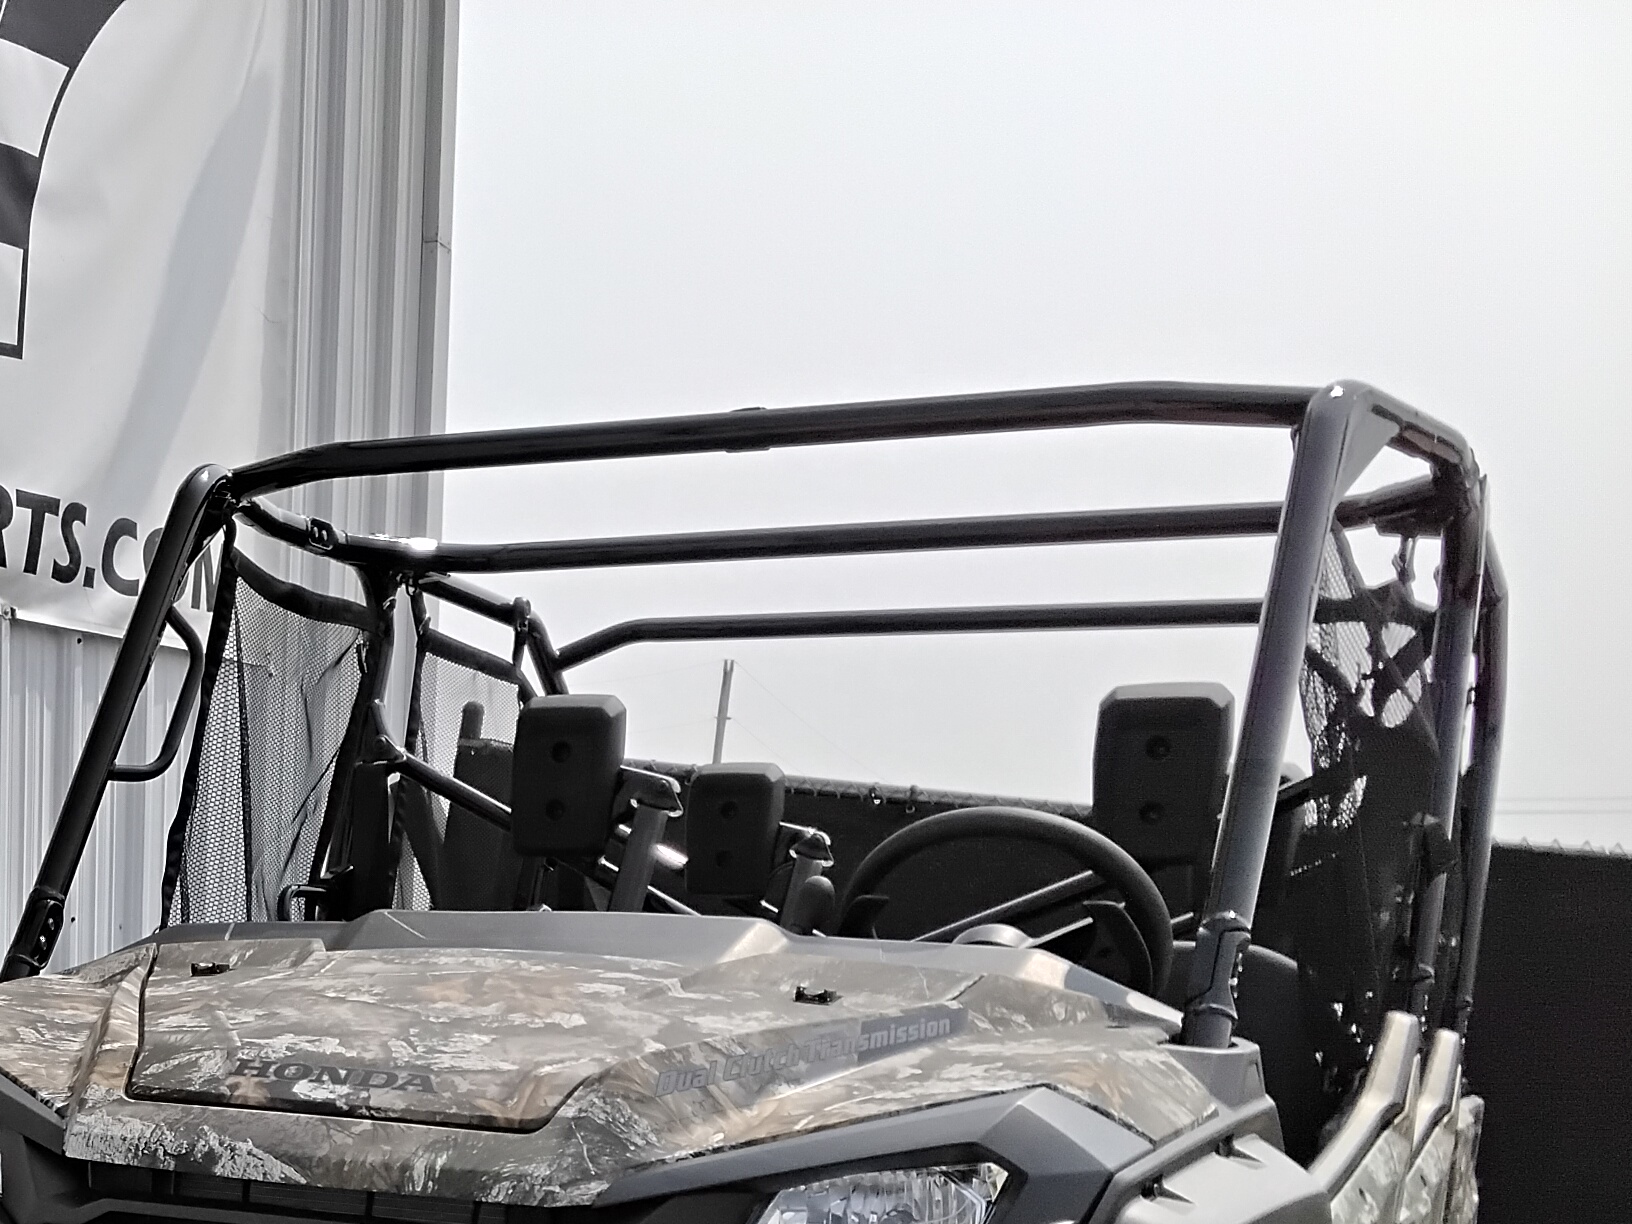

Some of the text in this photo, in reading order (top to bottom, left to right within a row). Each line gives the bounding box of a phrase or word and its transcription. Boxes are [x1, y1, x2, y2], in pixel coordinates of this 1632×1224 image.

[227, 1057, 439, 1094] HONDA
[654, 1016, 951, 1097] Dual Clutch Transmission
